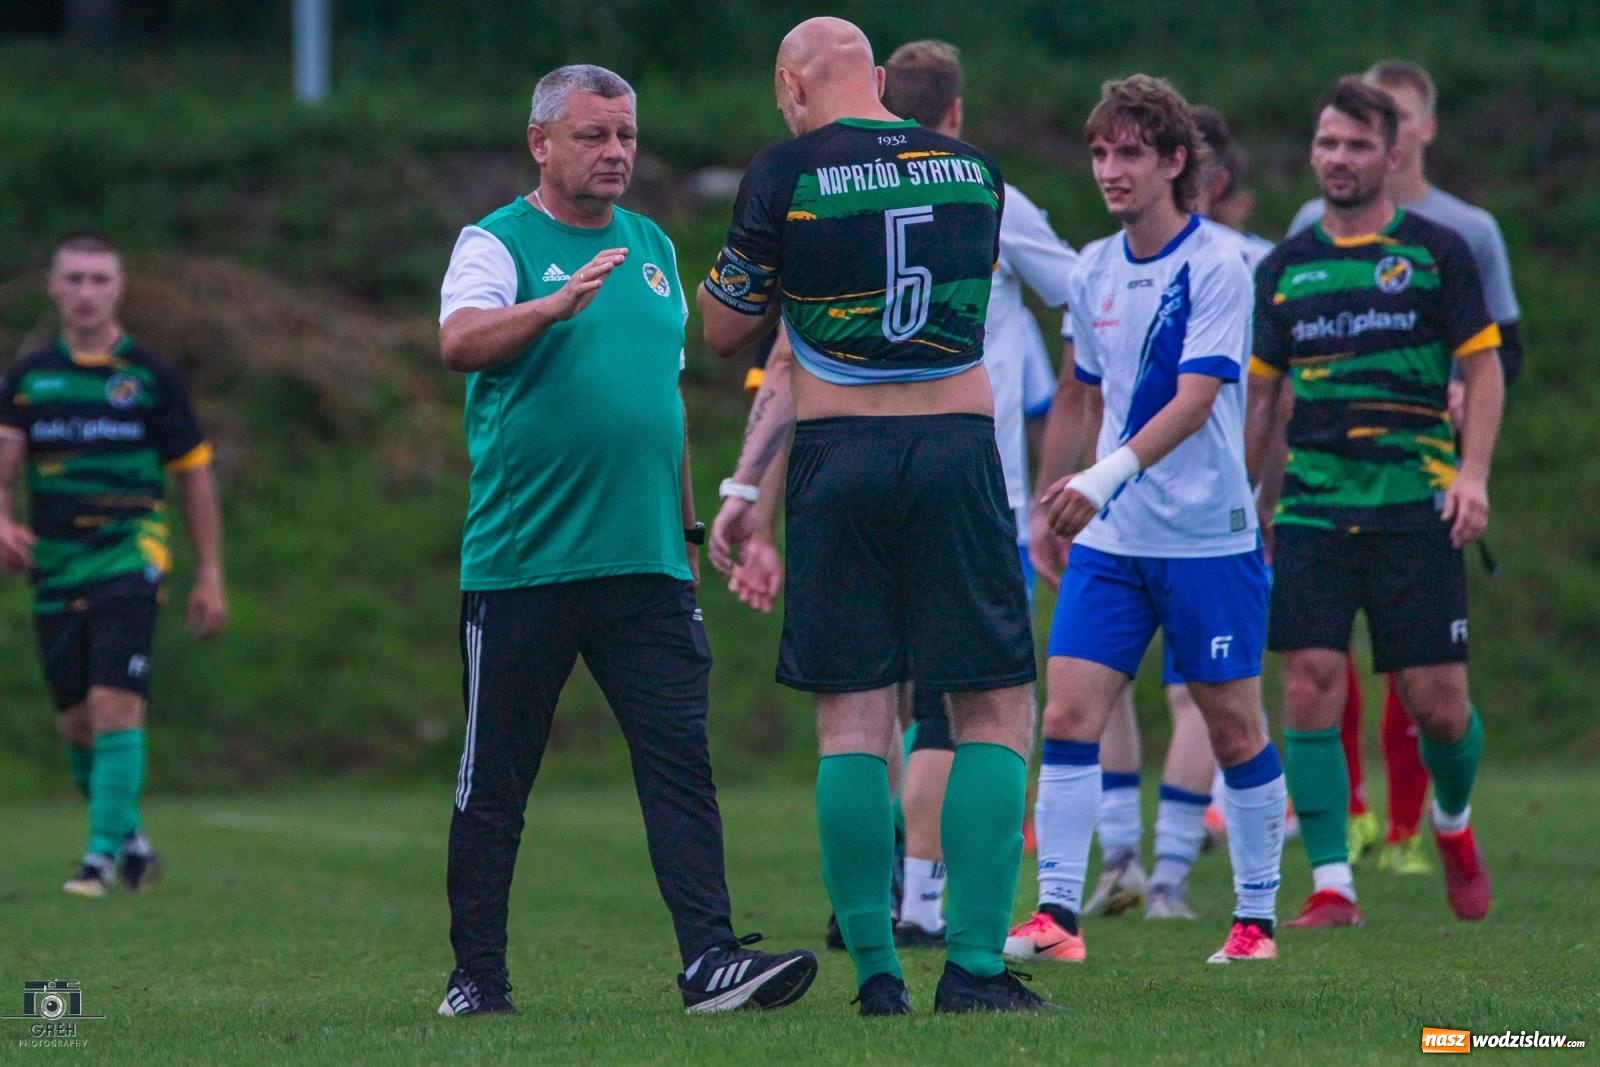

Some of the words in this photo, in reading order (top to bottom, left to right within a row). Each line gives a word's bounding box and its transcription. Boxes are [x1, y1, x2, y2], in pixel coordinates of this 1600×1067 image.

[877, 134, 908, 146] 1932
[816, 157, 901, 196] NAPRZÓD
[906, 158, 984, 186] SYRYNIA
